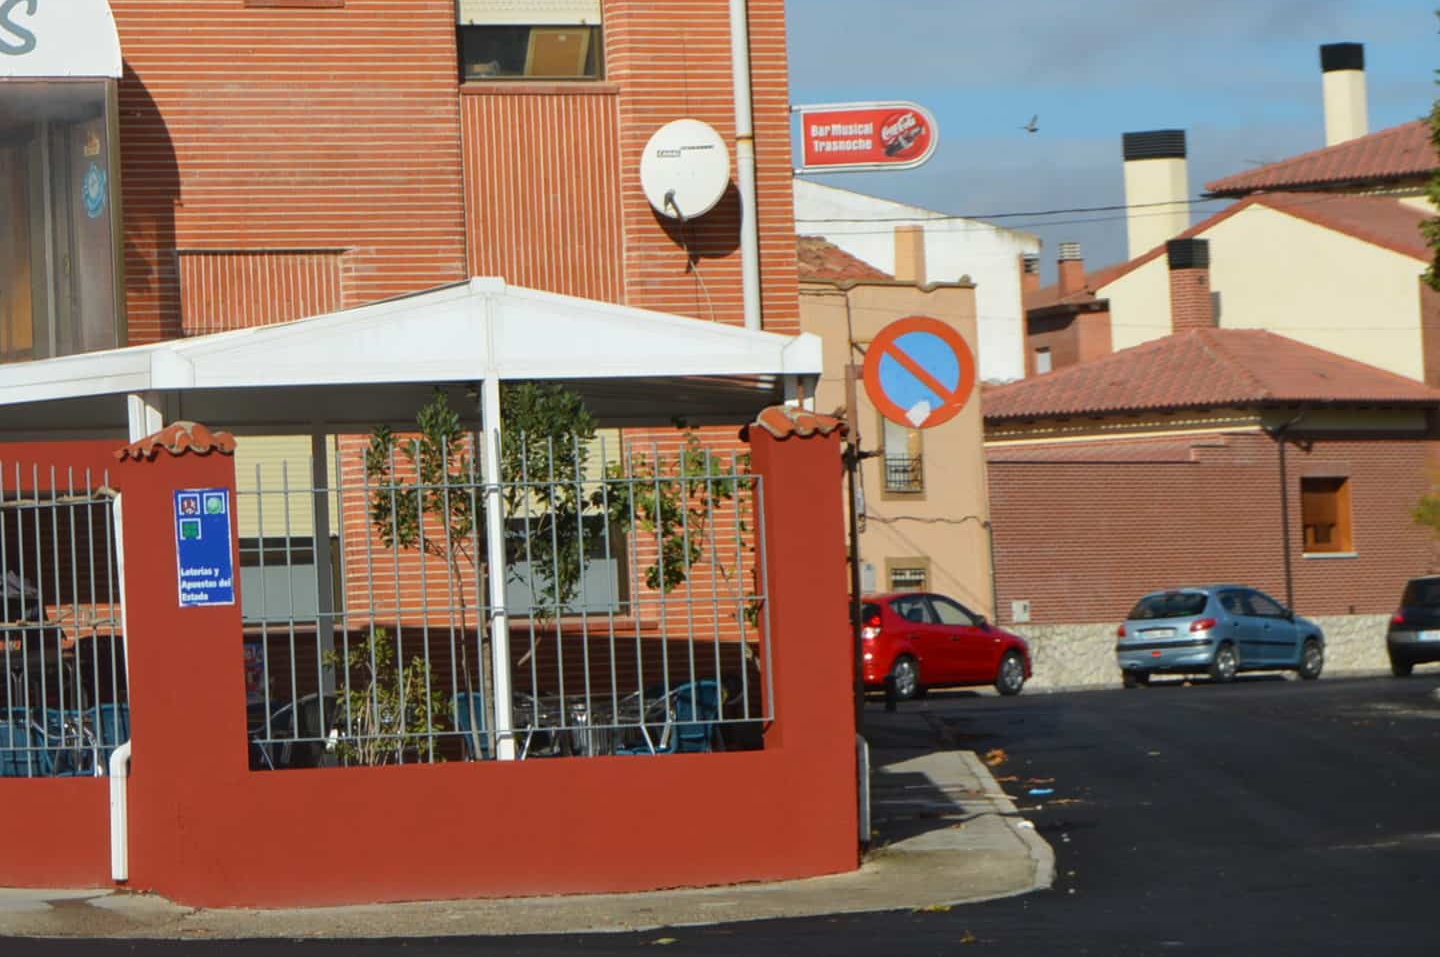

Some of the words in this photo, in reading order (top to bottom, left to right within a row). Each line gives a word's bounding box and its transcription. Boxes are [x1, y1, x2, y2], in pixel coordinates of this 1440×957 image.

[811, 124, 831, 137] Bar
[214, 568, 220, 577] y
[219, 577, 231, 587] del
[182, 591, 209, 602] Estado
